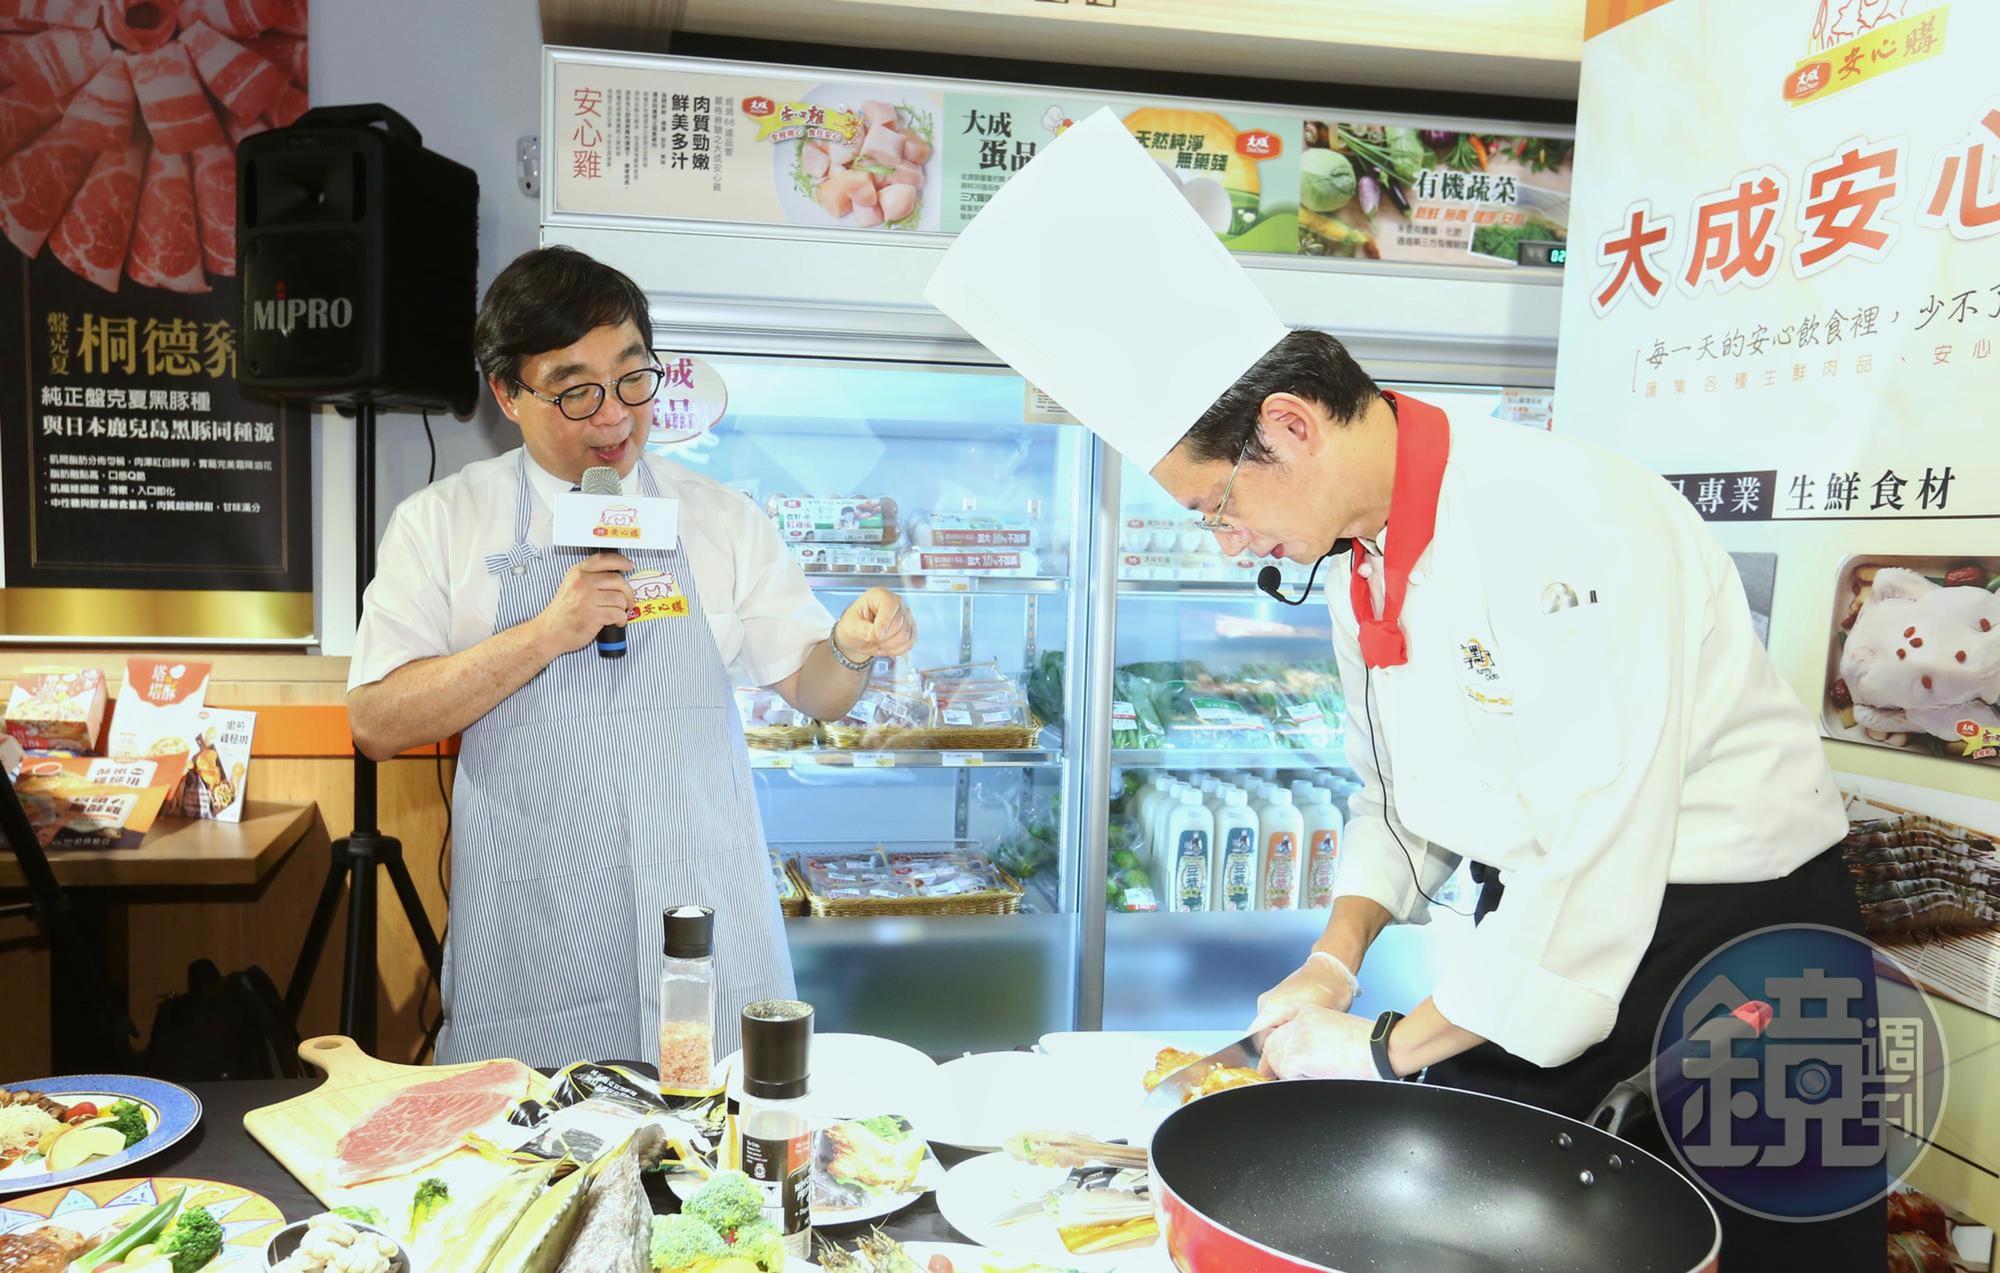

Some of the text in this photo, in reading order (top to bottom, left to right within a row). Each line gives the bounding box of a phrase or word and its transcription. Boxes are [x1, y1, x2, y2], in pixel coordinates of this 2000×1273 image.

[1838, 15, 1938, 81] 安心購
[573, 88, 602, 180] 安心雞
[671, 94, 689, 170] 鮮美多汁
[692, 96, 710, 170] 肉質勁嫩
[962, 109, 1012, 138] 大成
[1136, 130, 1204, 152] 天然純淨
[979, 139, 1037, 172] 蛋品
[1176, 152, 1228, 172] 無藥殘
[1415, 170, 1516, 202] 有機蔬菜
[254, 297, 352, 332] MIPRO
[47, 312, 70, 376] 盤克夏
[42, 386, 211, 412] 純正盤克夏黑豚種
[1786, 467, 1956, 512] 生鮮食材
